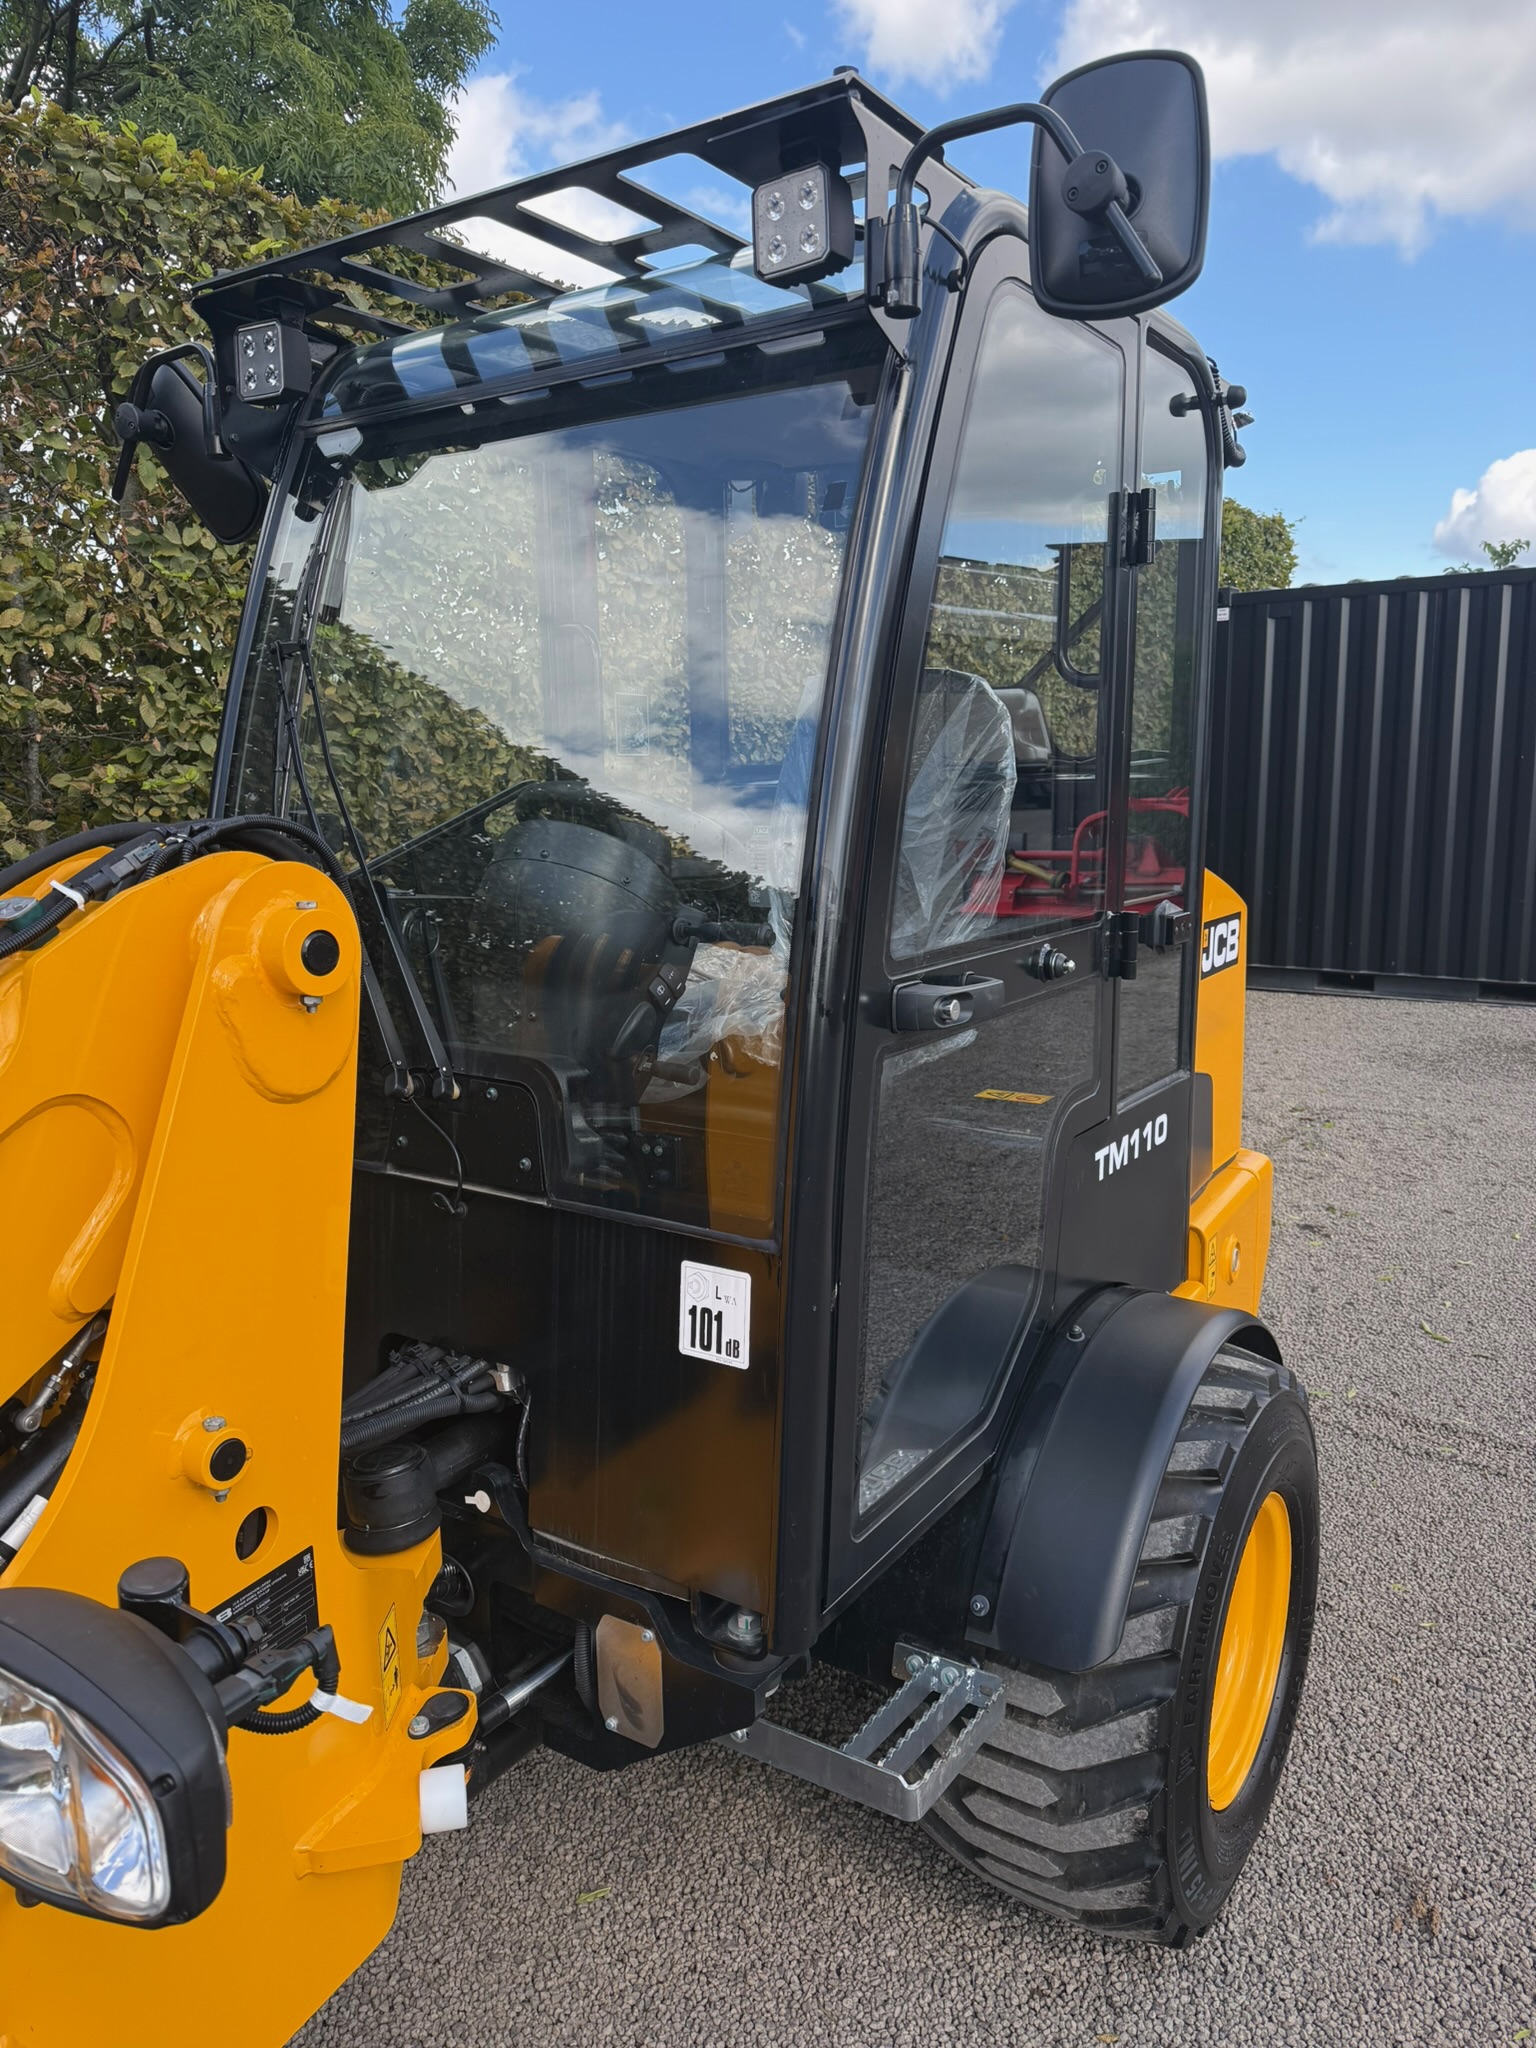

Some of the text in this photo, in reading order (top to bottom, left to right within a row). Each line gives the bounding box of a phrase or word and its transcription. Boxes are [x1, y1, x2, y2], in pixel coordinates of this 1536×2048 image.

[1202, 918, 1240, 973] JCB
[1094, 1113, 1168, 1182] TM110
[688, 1304, 740, 1359] 101 dB
